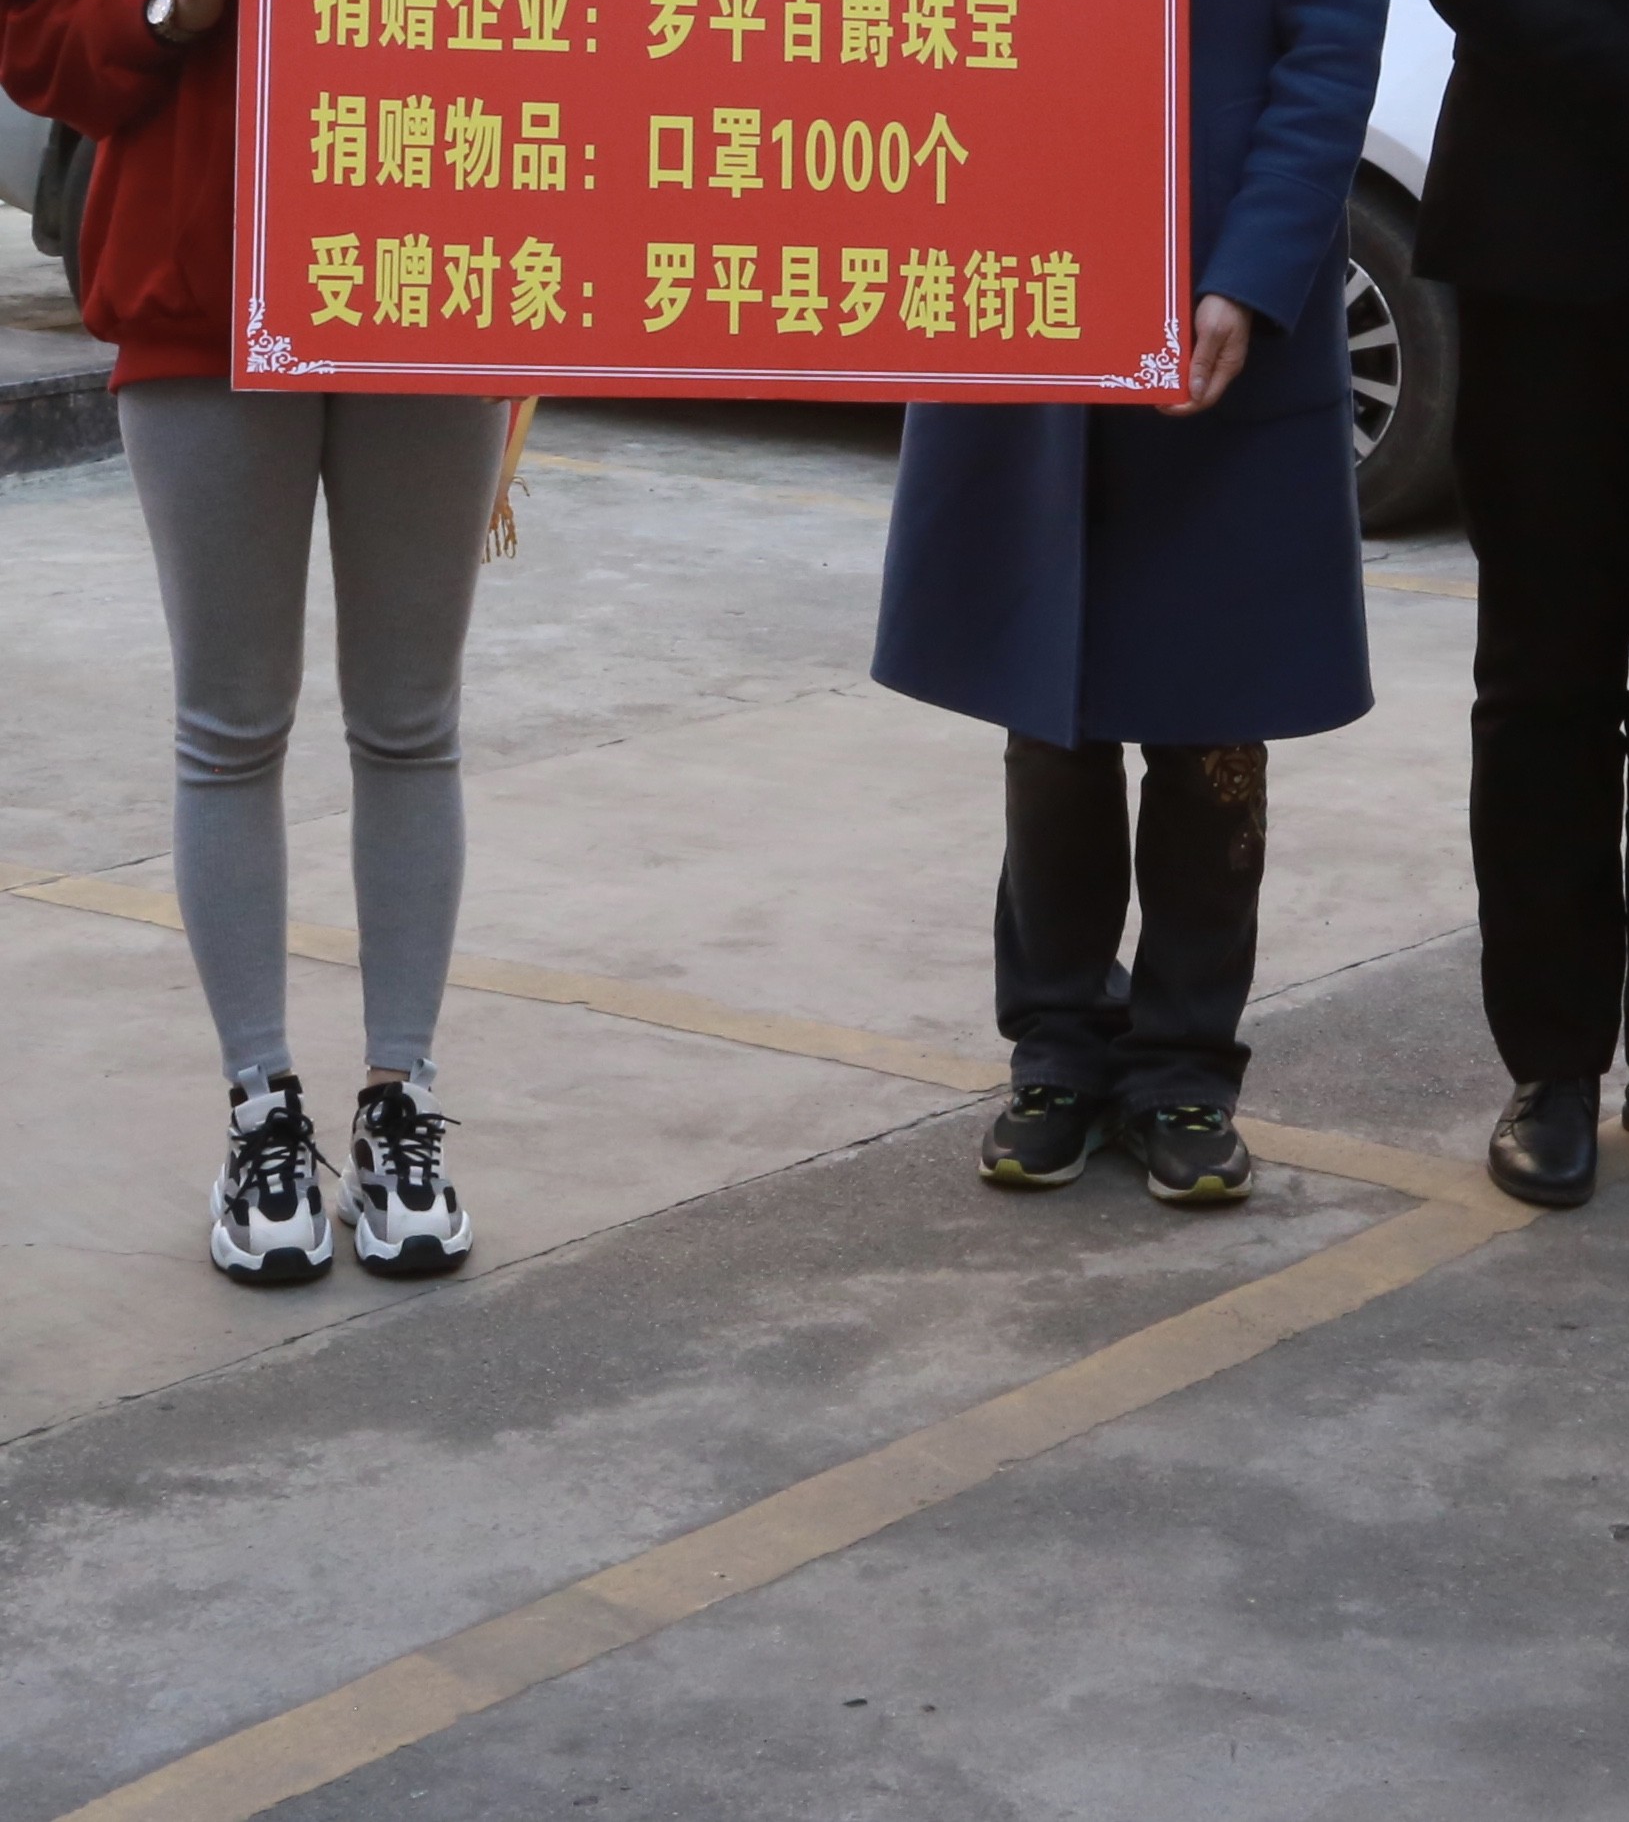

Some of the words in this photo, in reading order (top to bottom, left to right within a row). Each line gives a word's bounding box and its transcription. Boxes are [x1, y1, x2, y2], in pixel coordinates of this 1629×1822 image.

[310, 92, 596, 191] 捐赠物品：
[648, 107, 969, 204] 口罩1000个
[307, 233, 594, 330] 受赠对象：
[643, 241, 1081, 340] 罗平县罗雄街道
